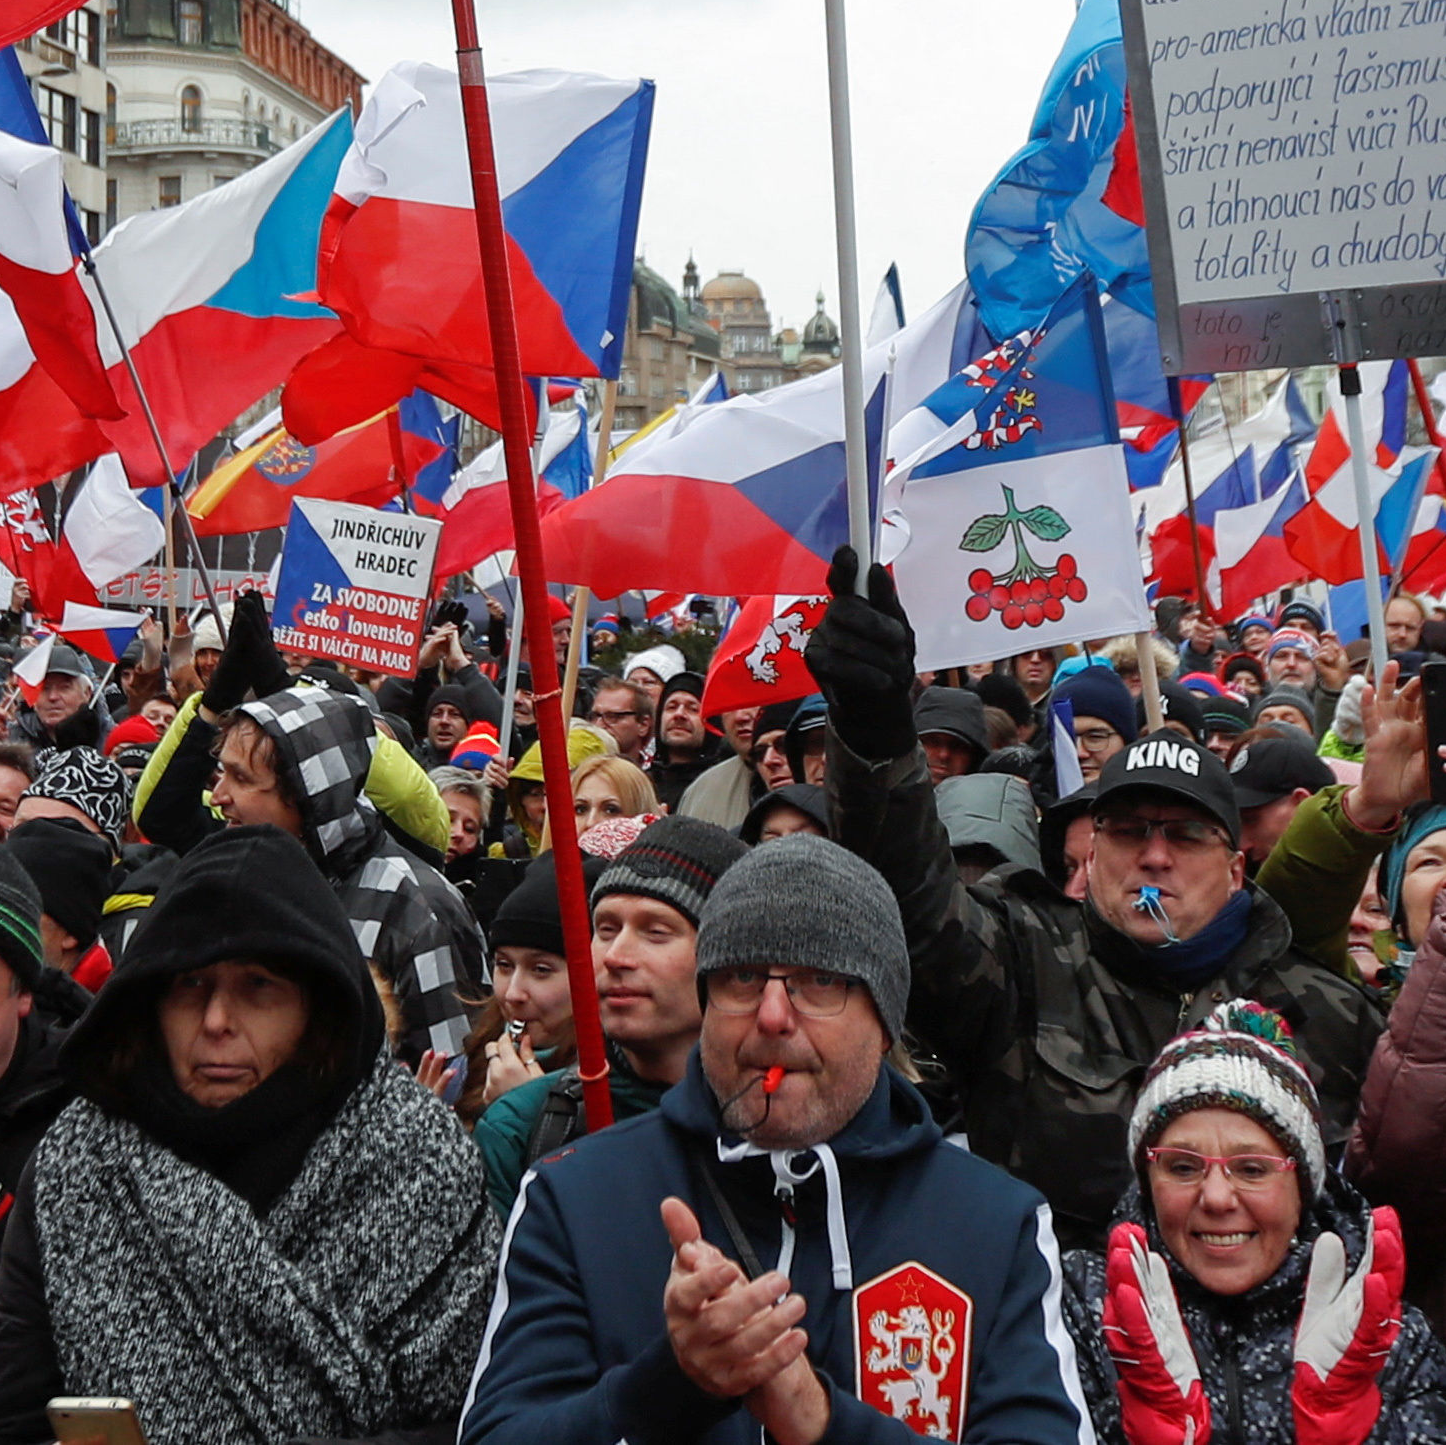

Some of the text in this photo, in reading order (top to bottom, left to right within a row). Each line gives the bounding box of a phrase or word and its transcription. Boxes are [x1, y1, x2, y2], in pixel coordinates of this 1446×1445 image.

[1162, 52, 1319, 140] podporující
[1162, 122, 1236, 177] šířící
[1234, 109, 1341, 168] nenávist
[1346, 107, 1399, 151] vůči
[1177, 205, 1196, 232] a
[1206, 165, 1325, 229] táhnoucí
[1329, 161, 1379, 212] nás
[1382, 155, 1416, 208] do
[1194, 227, 1298, 293] totality
[1311, 241, 1331, 270] a
[1193, 308, 1243, 335] toto
[331, 518, 427, 550] JINDŘICHŮV
[354, 550, 418, 578] HRADEC
[311, 582, 421, 621] ZA SVOBODNÉ
[272, 625, 412, 672] BĚŽTE SI VÁLČIT NA MARS
[1125, 740, 1201, 777] KING
